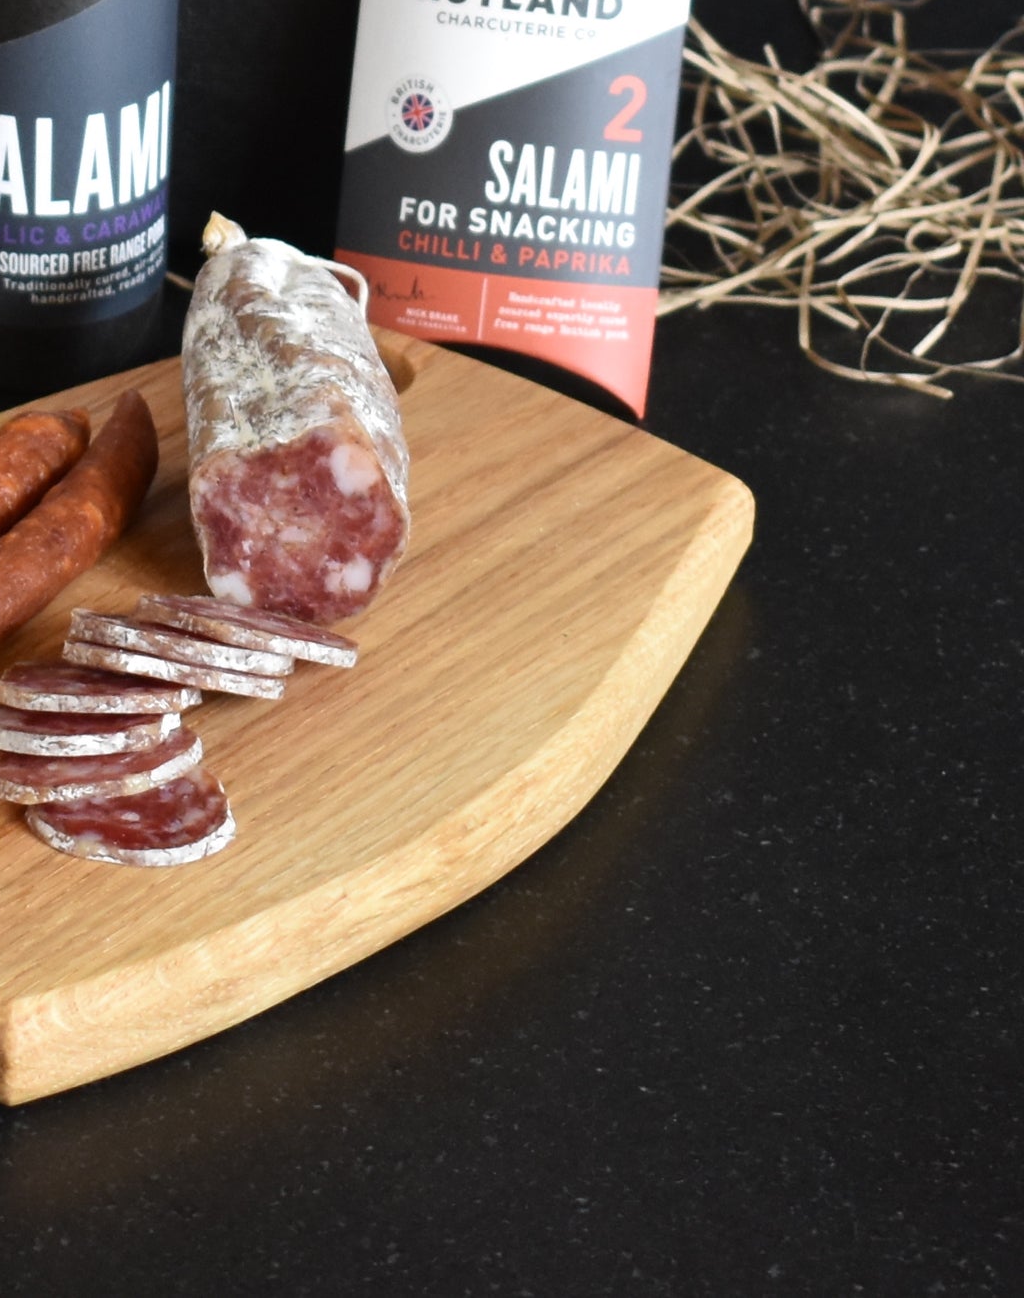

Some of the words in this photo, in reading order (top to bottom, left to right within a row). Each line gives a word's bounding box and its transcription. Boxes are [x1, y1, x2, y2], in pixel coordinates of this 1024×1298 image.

[436, 11, 566, 39] CHARCUTERIE
[391, 79, 435, 105] BRITISH
[603, 75, 647, 142] 2
[484, 139, 640, 216] SALAMI
[55, 226, 72, 245] &
[398, 196, 457, 230] FOR
[468, 206, 636, 248] SNACKING
[0, 251, 69, 276] SOURCED
[73, 246, 106, 273] FREE
[110, 231, 146, 266] RANGE
[398, 229, 480, 263] CHILLI
[490, 245, 508, 266] &
[518, 249, 631, 276] PAPRIKA
[3, 277, 91, 292] Traditionally
